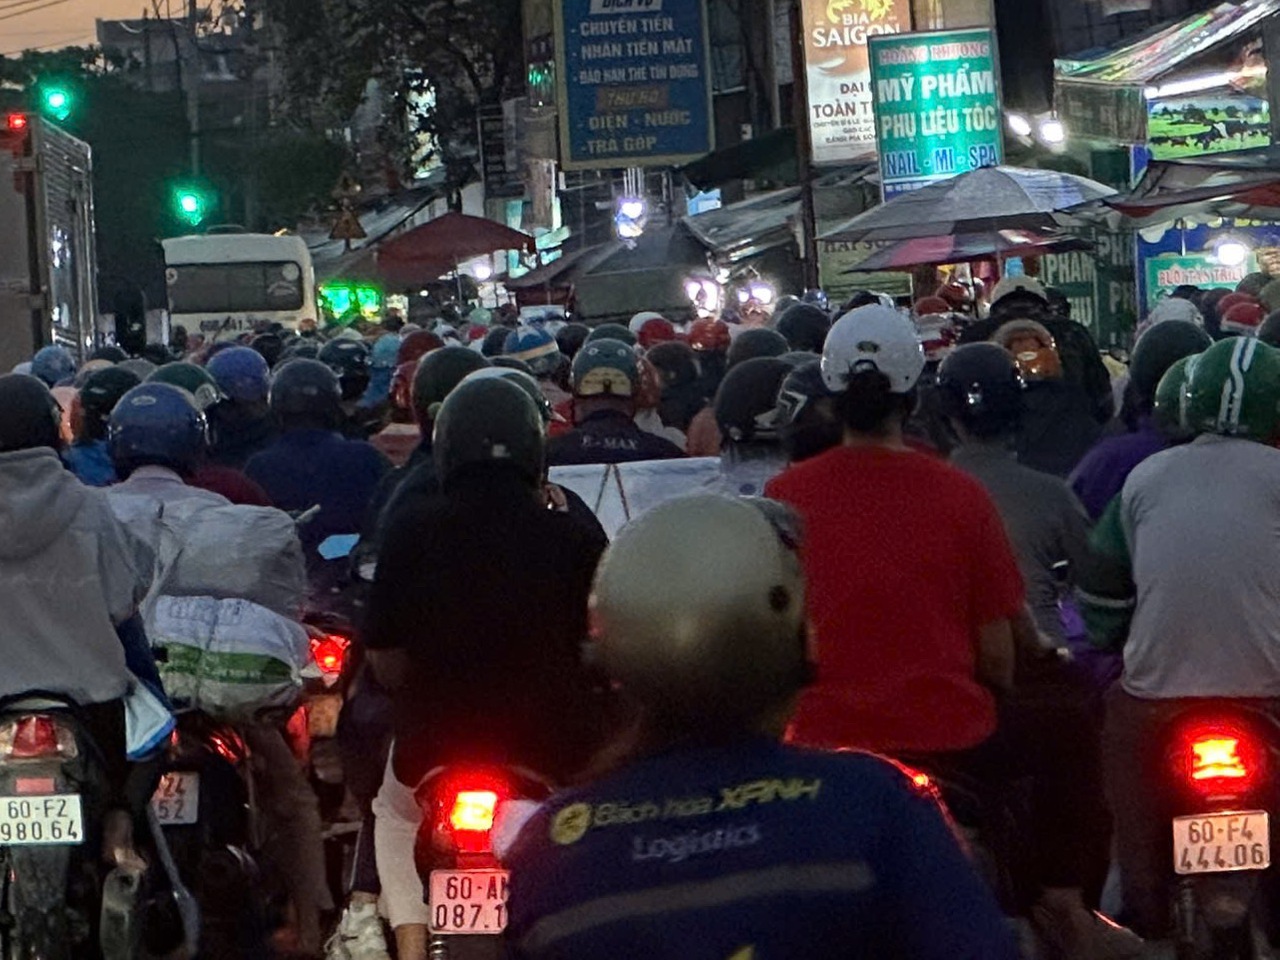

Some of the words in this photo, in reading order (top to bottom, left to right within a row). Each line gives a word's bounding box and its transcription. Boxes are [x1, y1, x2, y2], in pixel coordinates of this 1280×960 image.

[842, 12, 869, 26] BIA
[877, 73, 915, 103] MỸ
[920, 63, 994, 99] PHẨM
[812, 99, 857, 119] TOÀN
[881, 112, 917, 142] PHỤ
[920, 105, 959, 139] LIỆU
[962, 102, 997, 132] TÓC
[884, 149, 921, 176] NAIL
[934, 147, 955, 171] MI
[969, 143, 998, 169] SPA
[7, 797, 69, 820] 60-F2
[0, 820, 79, 842] 980.64
[1187, 817, 1254, 844] 60-F4
[1180, 843, 1264, 871] 444.06
